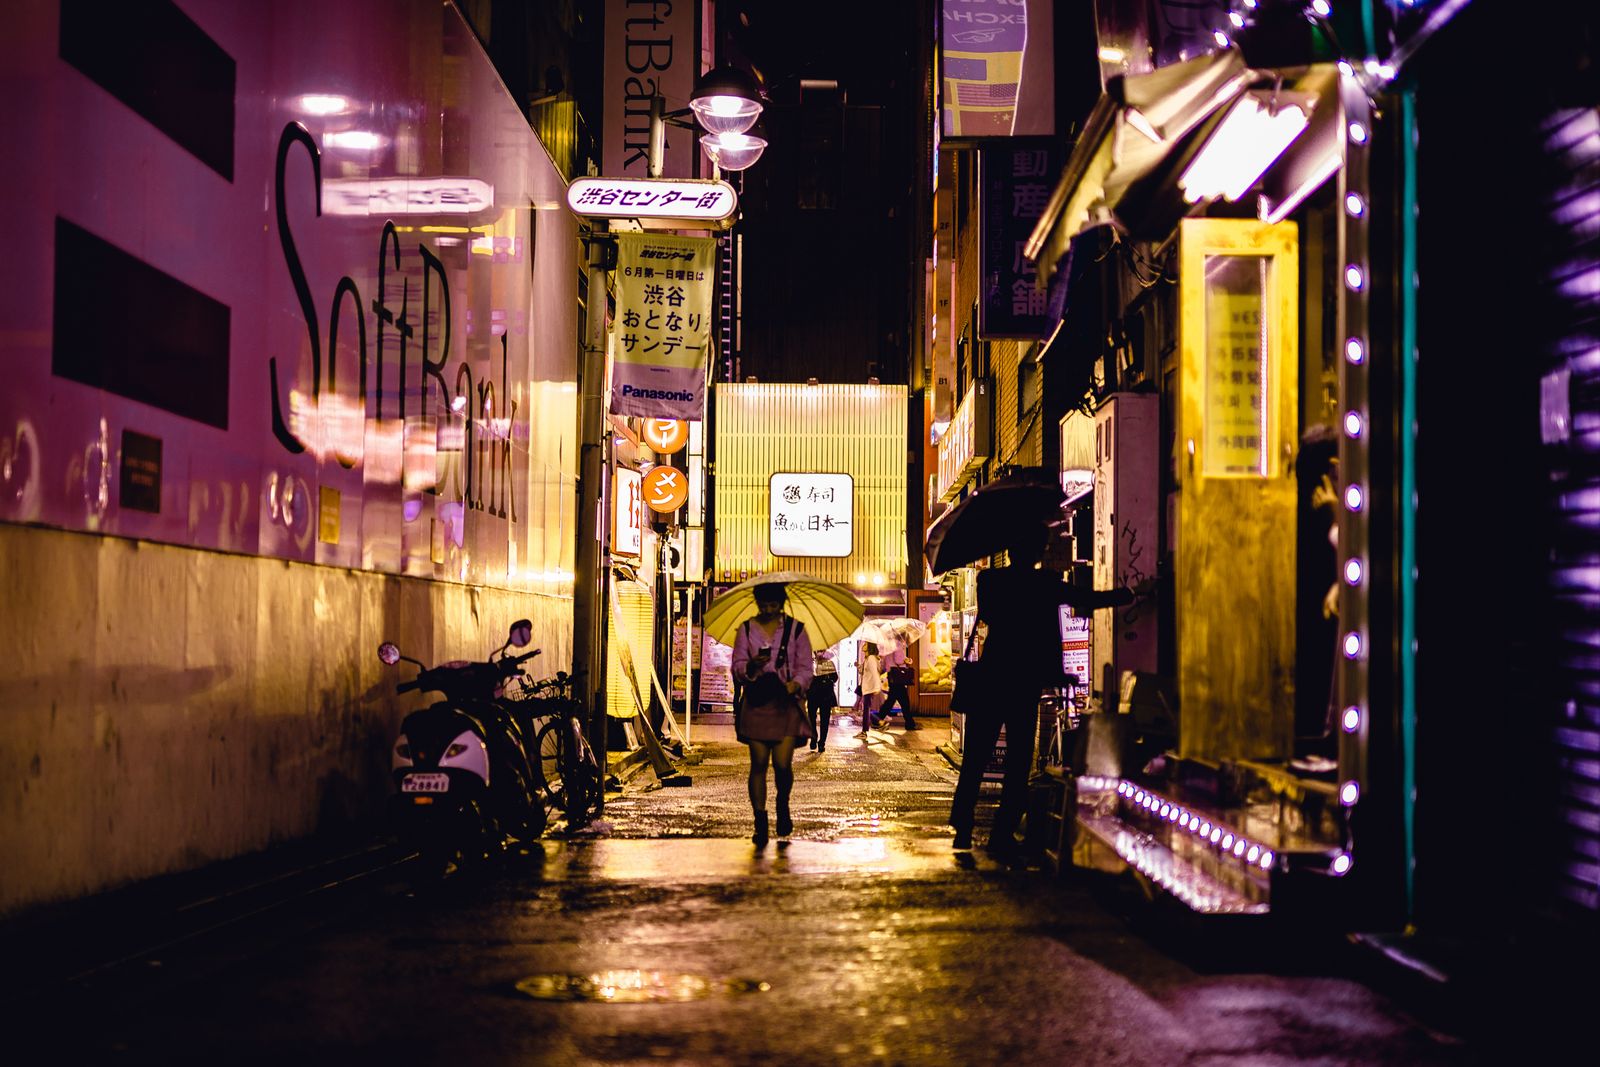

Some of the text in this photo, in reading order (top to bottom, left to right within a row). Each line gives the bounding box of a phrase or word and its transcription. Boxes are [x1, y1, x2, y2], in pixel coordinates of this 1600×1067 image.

[576, 187, 723, 209] 渋谷センター街
[624, 265, 705, 283] 6月第一日曜日は
[643, 283, 686, 308] 渋谷
[622, 308, 702, 333] おとなり
[620, 333, 702, 356] サンデー
[938, 377, 948, 385] B1
[622, 384, 695, 403] Panasonic
[773, 512, 850, 532] 魚がし日本一
